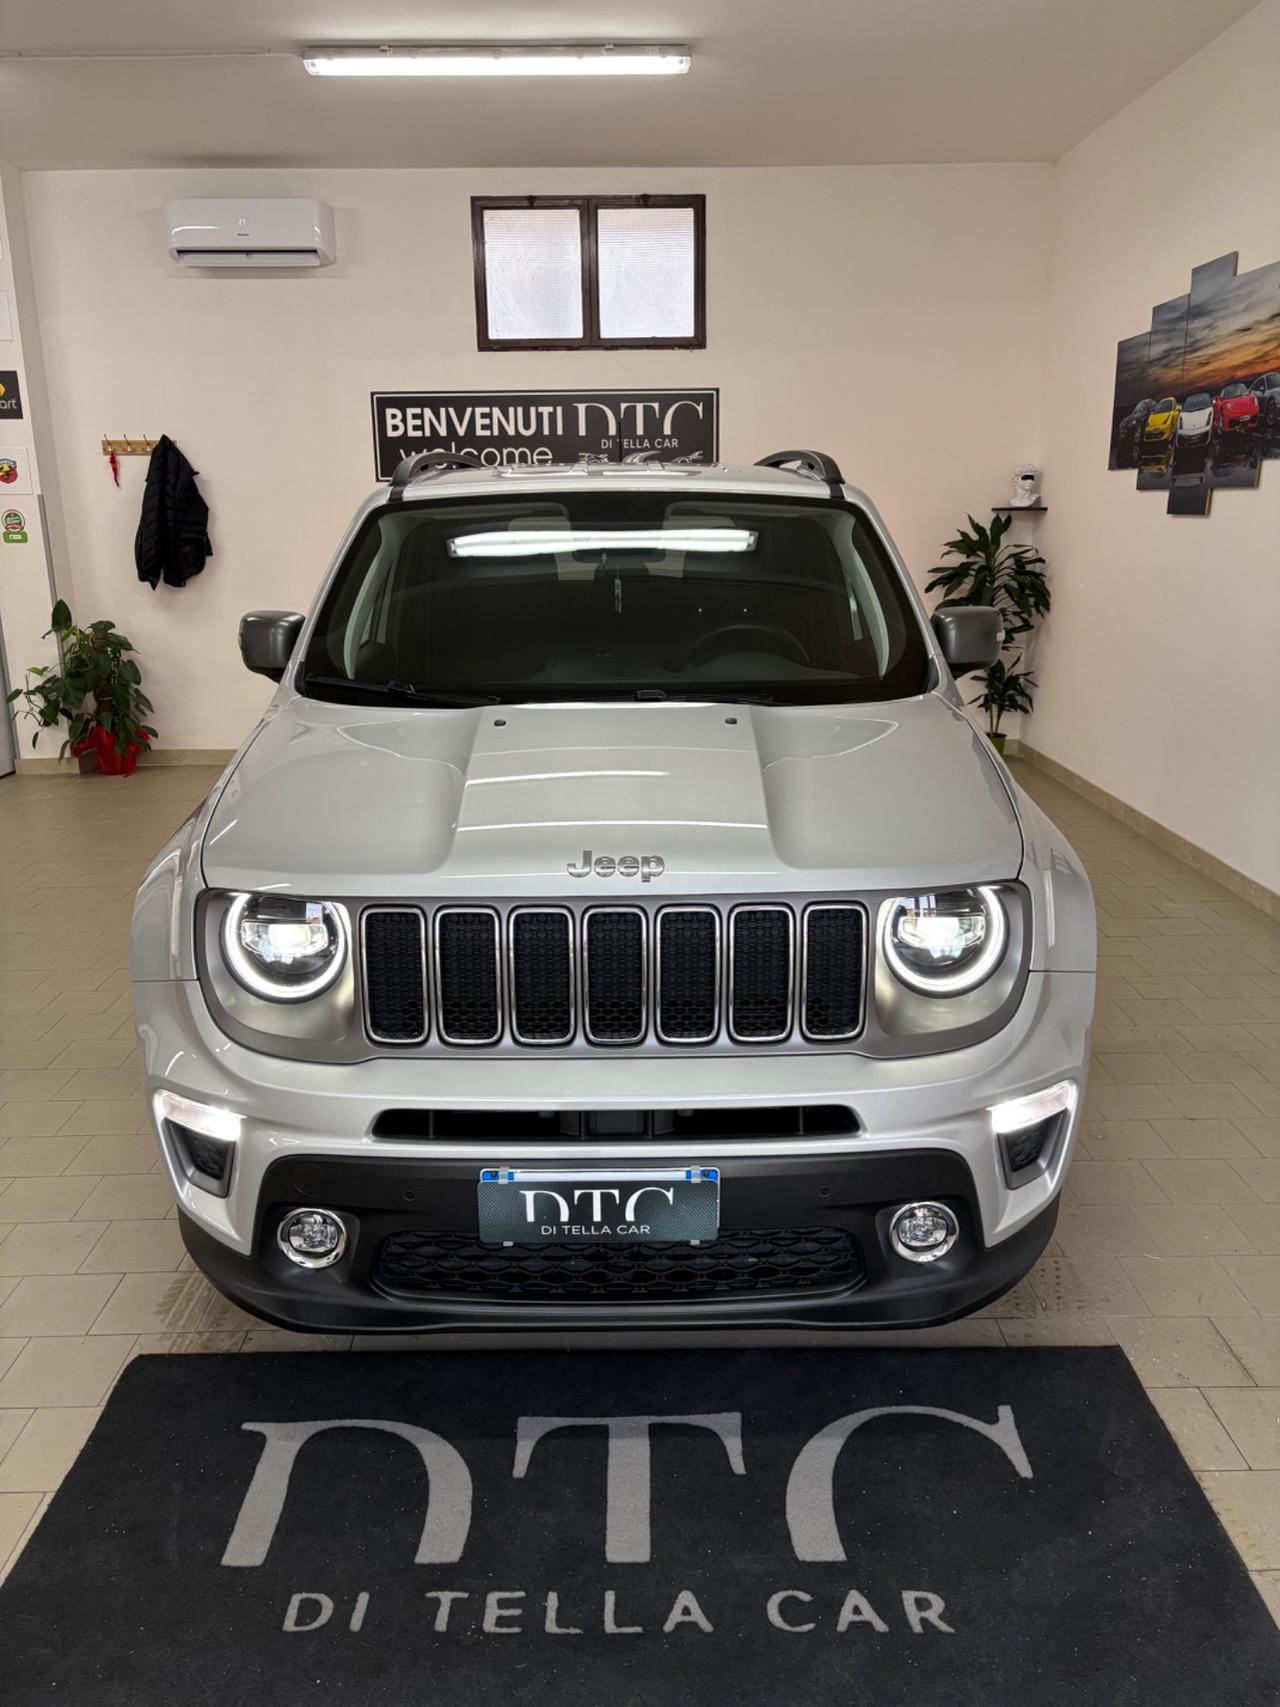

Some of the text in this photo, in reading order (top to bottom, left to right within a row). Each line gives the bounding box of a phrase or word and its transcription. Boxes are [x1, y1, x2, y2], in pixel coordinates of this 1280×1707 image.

[0, 398, 17, 409] art
[386, 405, 563, 437] BENVENUTI
[600, 438, 679, 449] DI ELLA CAR
[567, 850, 665, 882] Jeep
[541, 1225, 650, 1235] DI TELLA CAR
[282, 1589, 956, 1634] DI TELLA CAR
